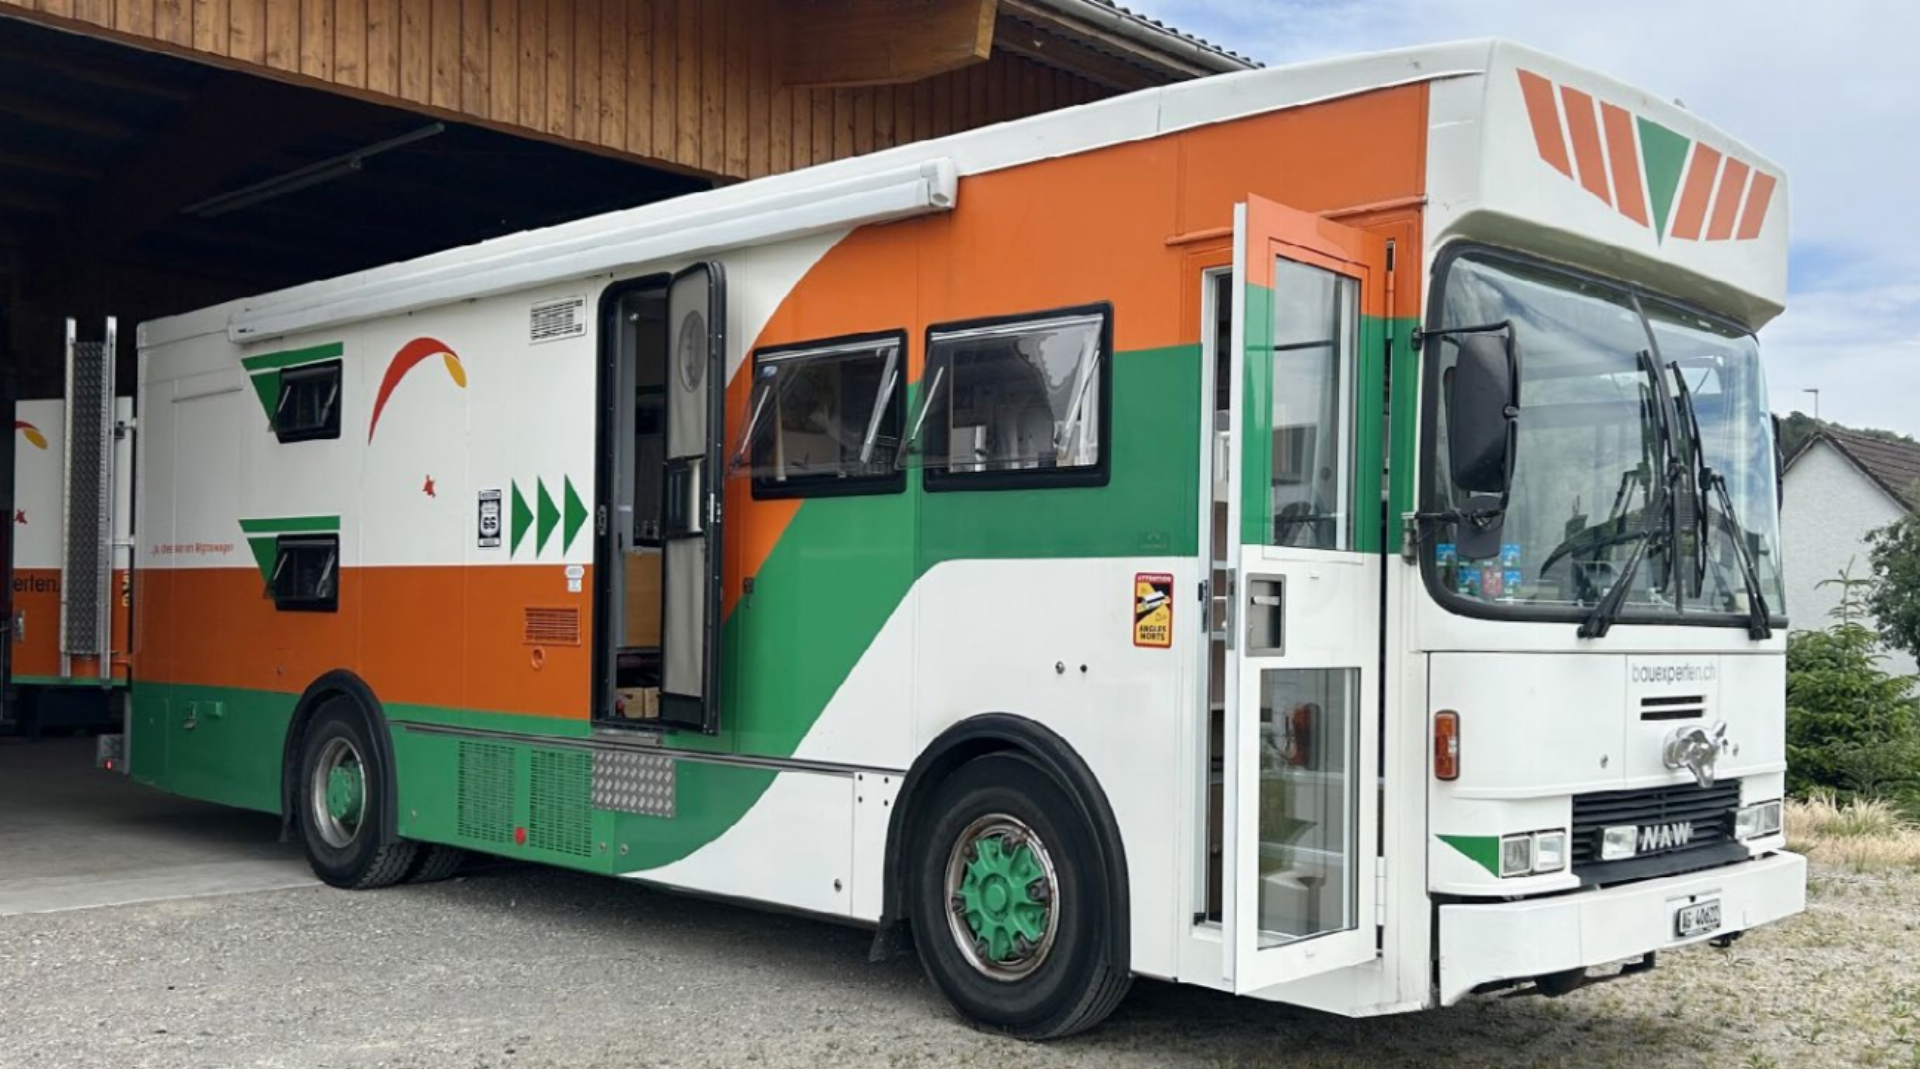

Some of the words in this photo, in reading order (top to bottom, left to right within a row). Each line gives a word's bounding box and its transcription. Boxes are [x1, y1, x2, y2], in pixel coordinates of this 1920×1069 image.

[483, 516, 496, 530] 66
[1139, 624, 1167, 633] ANGLES
[1140, 632, 1166, 641] MORTS
[1631, 662, 1717, 685] bauexperten.ch
[1641, 822, 1691, 851] NAW
